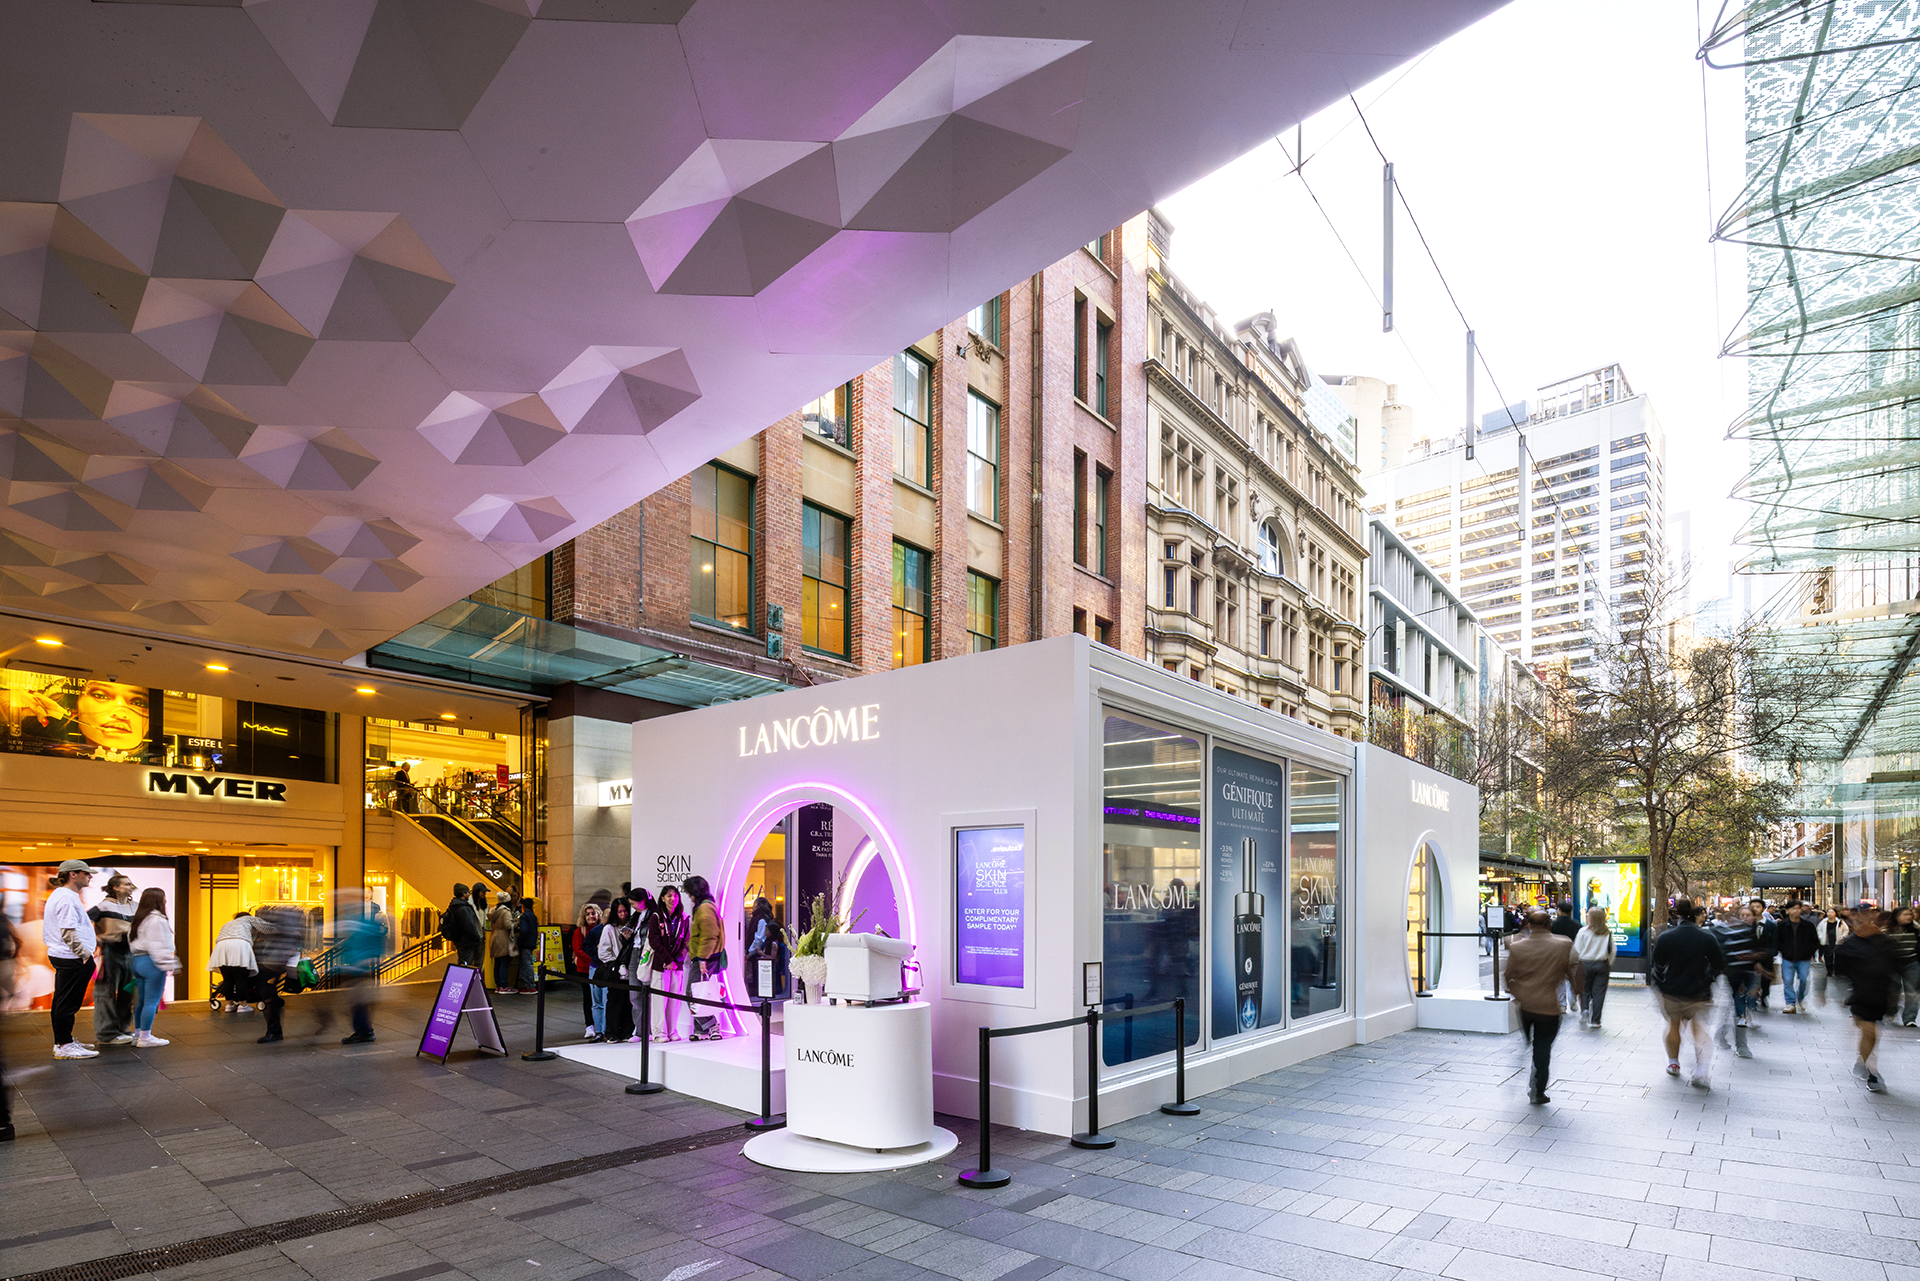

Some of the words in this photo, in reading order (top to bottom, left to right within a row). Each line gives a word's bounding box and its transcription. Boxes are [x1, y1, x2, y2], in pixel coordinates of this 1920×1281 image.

[739, 703, 880, 757] LANCÔME
[149, 772, 287, 801] MYER
[1222, 781, 1274, 811] GÉNIFIQUE
[1411, 779, 1450, 813] LANCÔME
[1231, 807, 1265, 824] ULTIMATE
[656, 854, 691, 873] SKIN
[1299, 855, 1336, 874] LANCÔME
[656, 872, 691, 883] SCIENCE
[976, 869, 1007, 880] SKIN
[1113, 880, 1196, 910] LANCÔME
[1299, 875, 1336, 905] SKIN
[1299, 905, 1336, 921] SCIENCE
[1236, 922, 1262, 934] LANCÔME
[797, 1048, 855, 1068] LANCÔME
